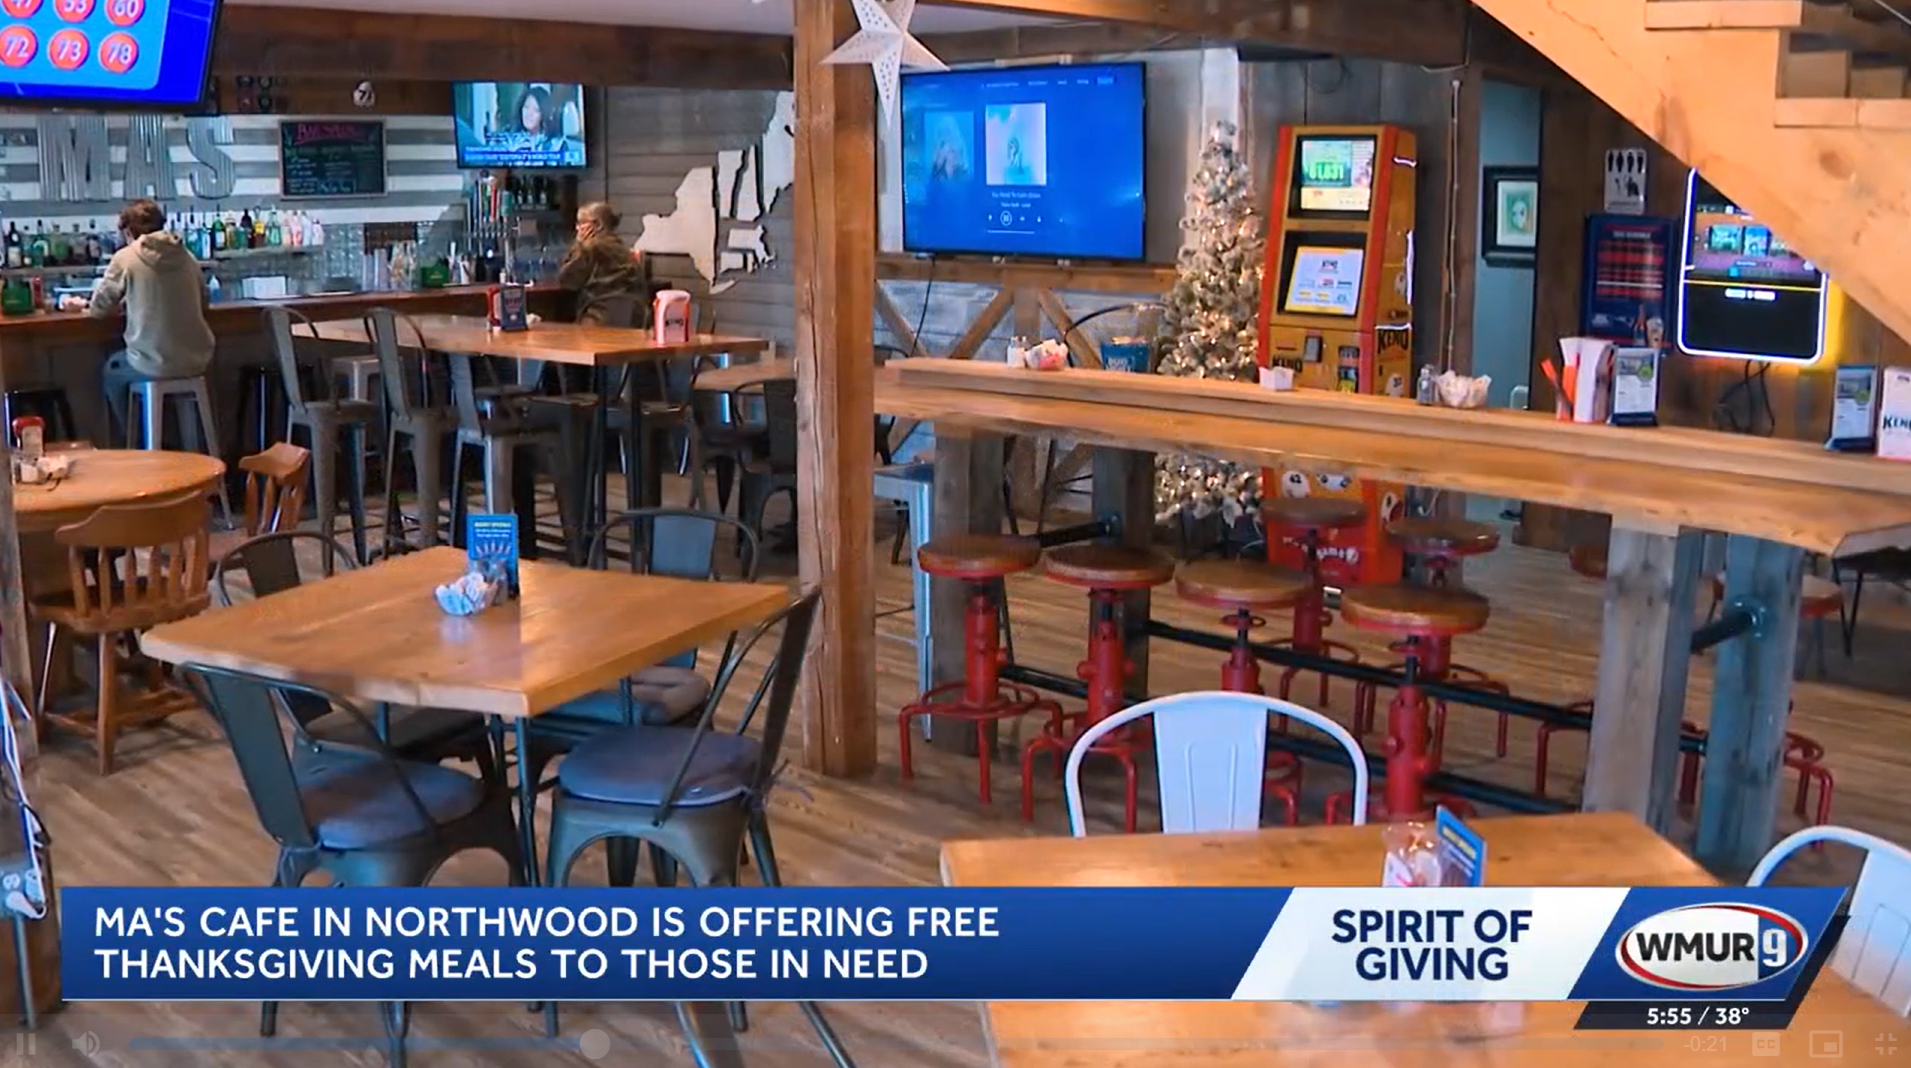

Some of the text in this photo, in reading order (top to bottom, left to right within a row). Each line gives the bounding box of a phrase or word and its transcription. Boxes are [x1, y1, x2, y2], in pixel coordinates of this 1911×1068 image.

[5, 36, 30, 58] 72
[57, 38, 82, 61] 73
[108, 42, 132, 65] 78
[1377, 328, 1408, 354] KENO
